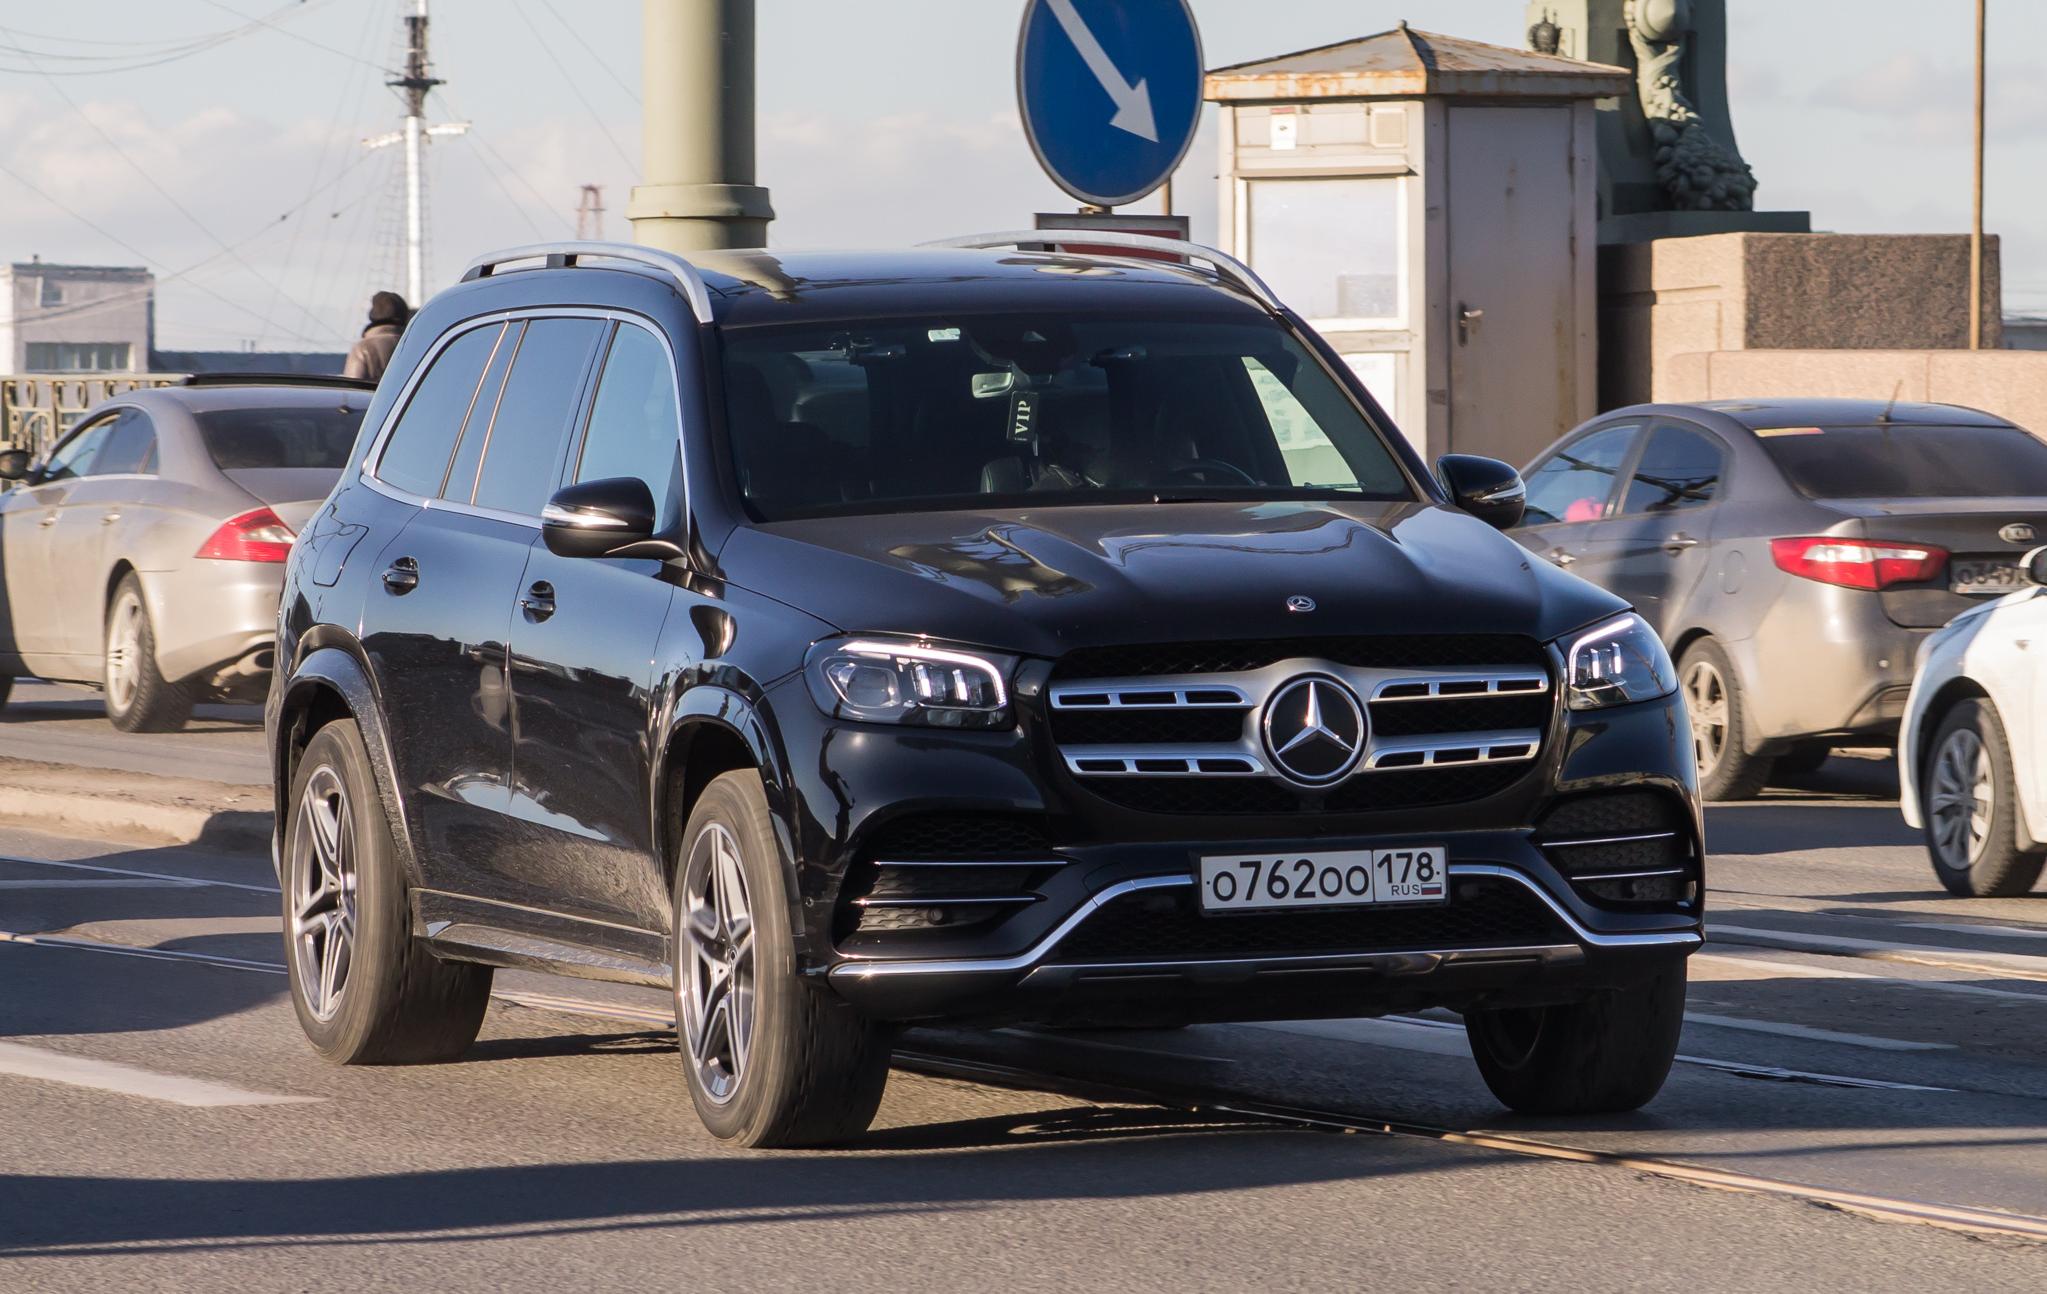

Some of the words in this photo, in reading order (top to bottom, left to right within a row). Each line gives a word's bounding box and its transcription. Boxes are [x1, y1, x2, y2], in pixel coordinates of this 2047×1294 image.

[1014, 400, 1031, 434] VIP
[1377, 851, 1434, 884] 178
[1391, 884, 1420, 895] RUS
